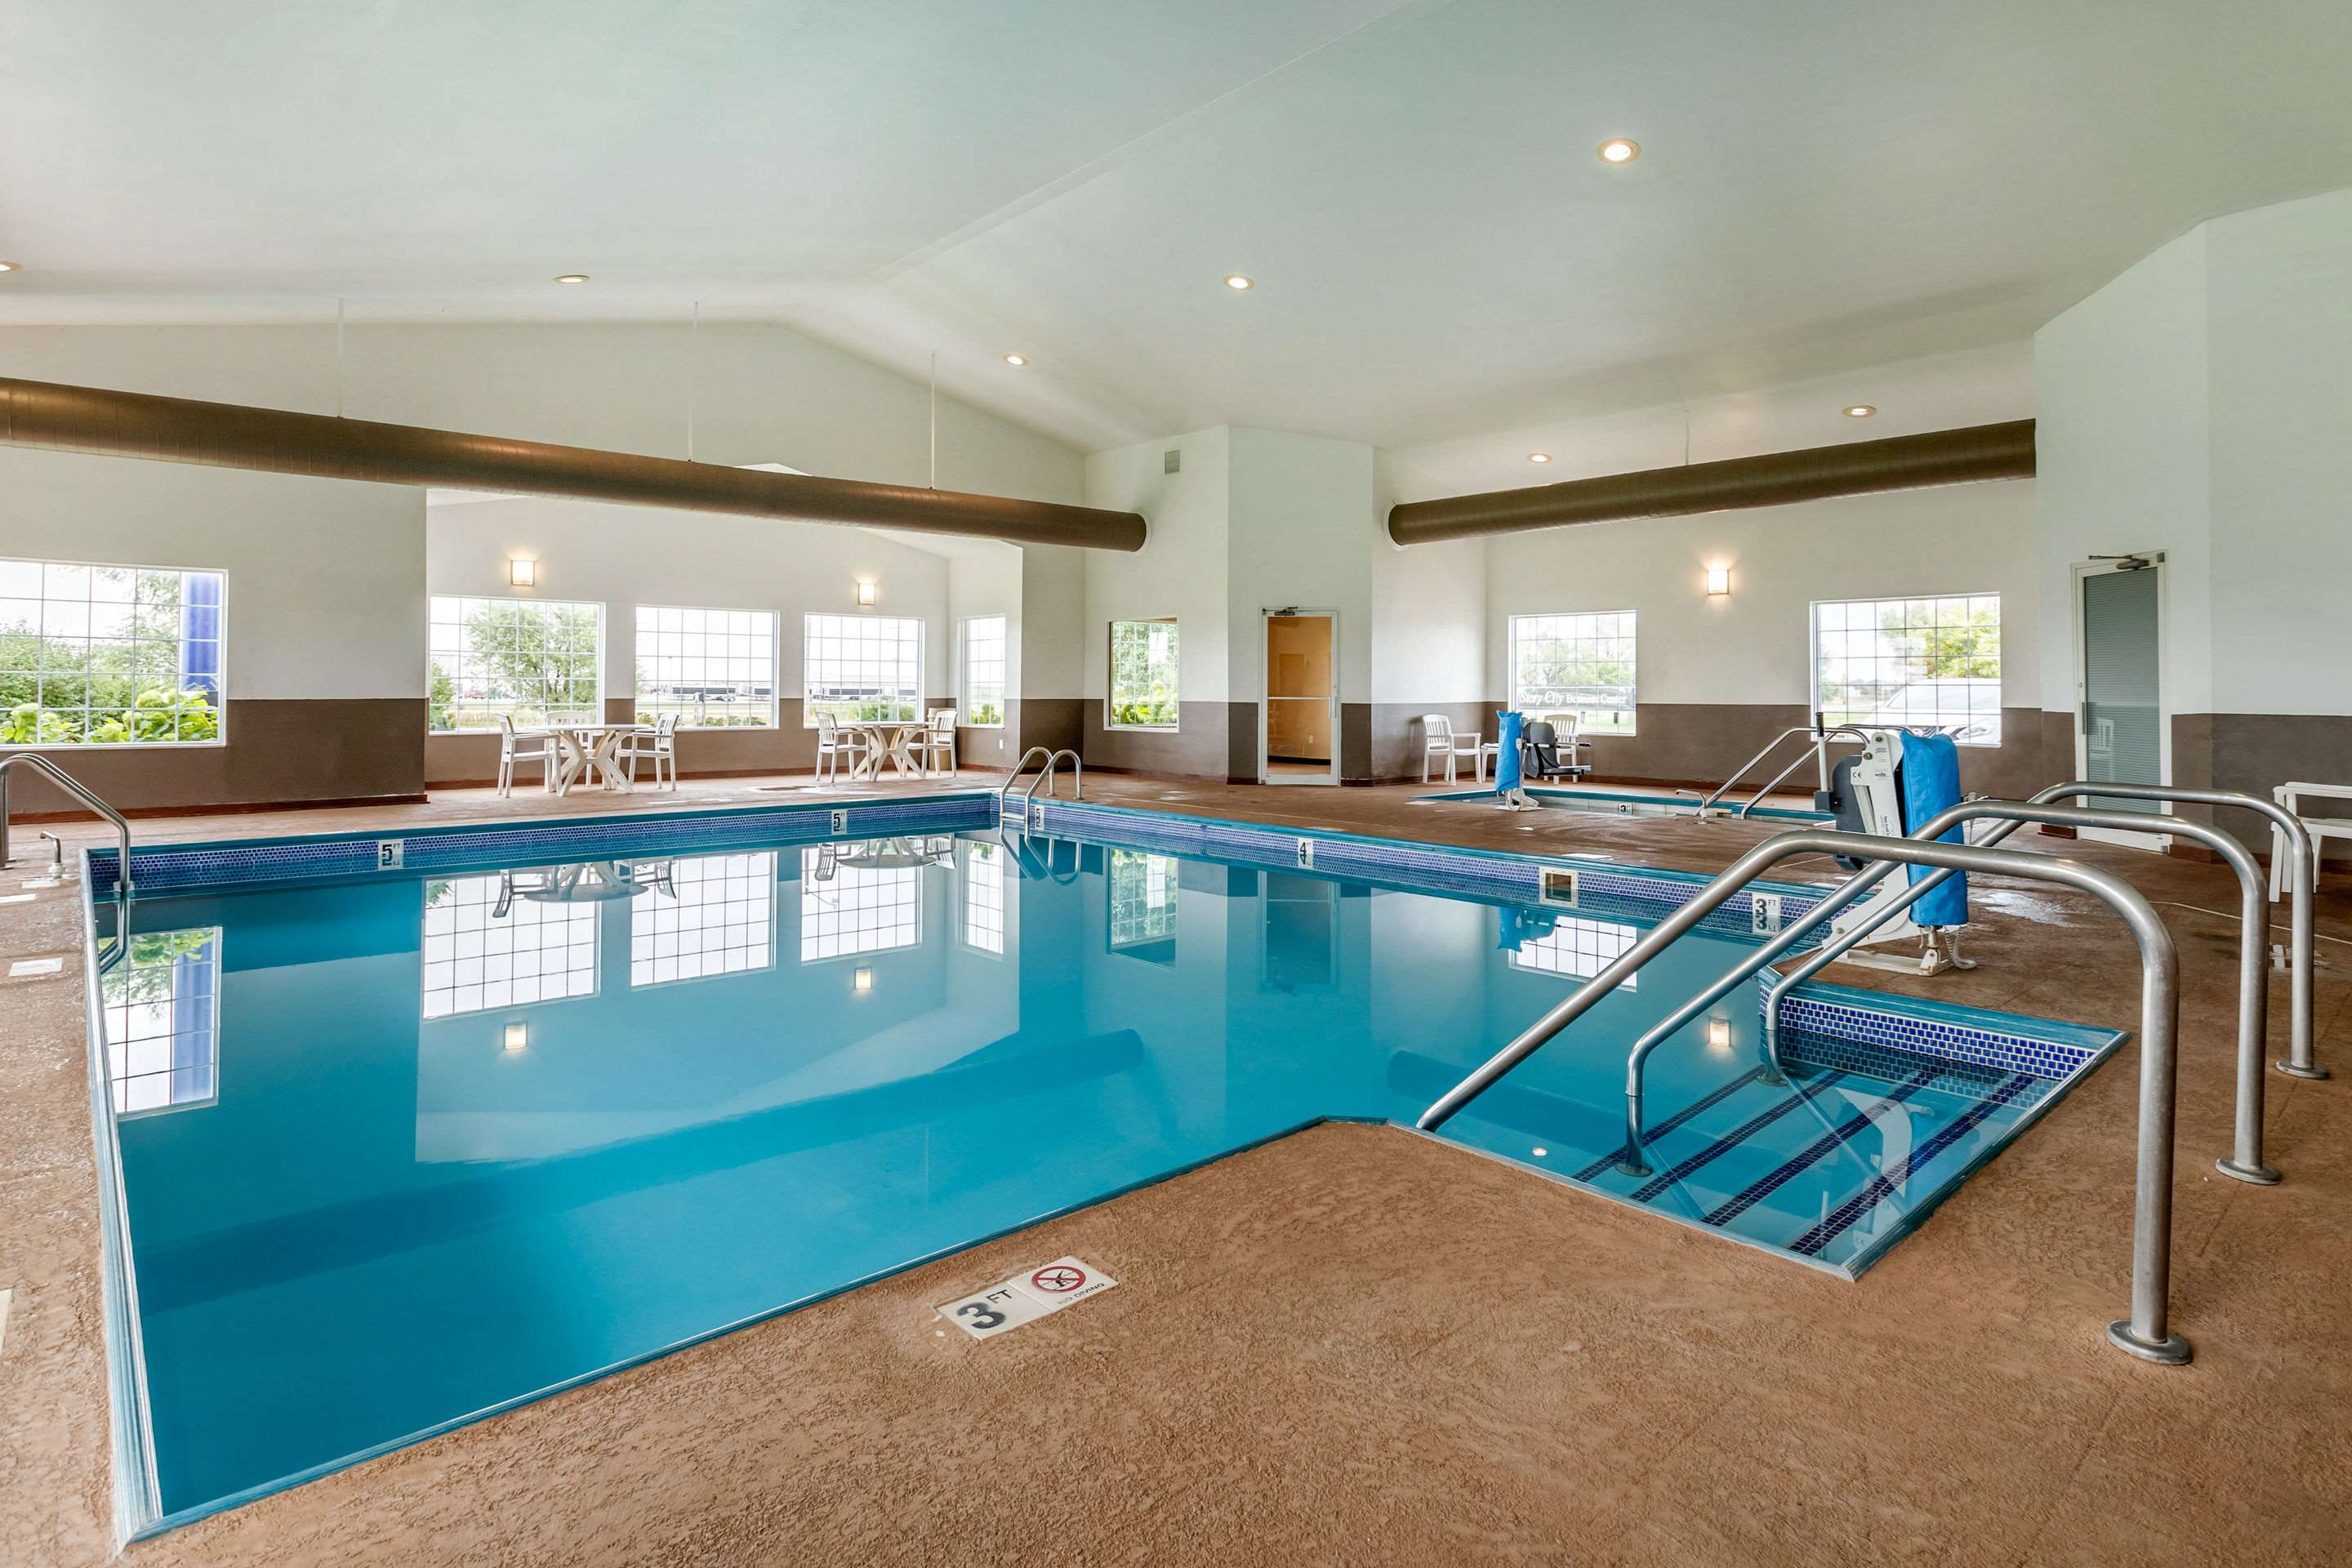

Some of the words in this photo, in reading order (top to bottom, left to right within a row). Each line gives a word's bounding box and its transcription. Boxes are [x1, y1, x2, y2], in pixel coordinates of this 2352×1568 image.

[1519, 691, 1544, 706] Story
[1544, 690, 1565, 706] City
[834, 813, 840, 824] 5
[382, 844, 392, 857] 5
[1300, 843, 1307, 854] 4
[1756, 898, 1767, 915] 3
[1074, 1283, 1105, 1298] DIVING
[956, 1302, 1007, 1330] 3
[986, 1289, 1013, 1304] FT
